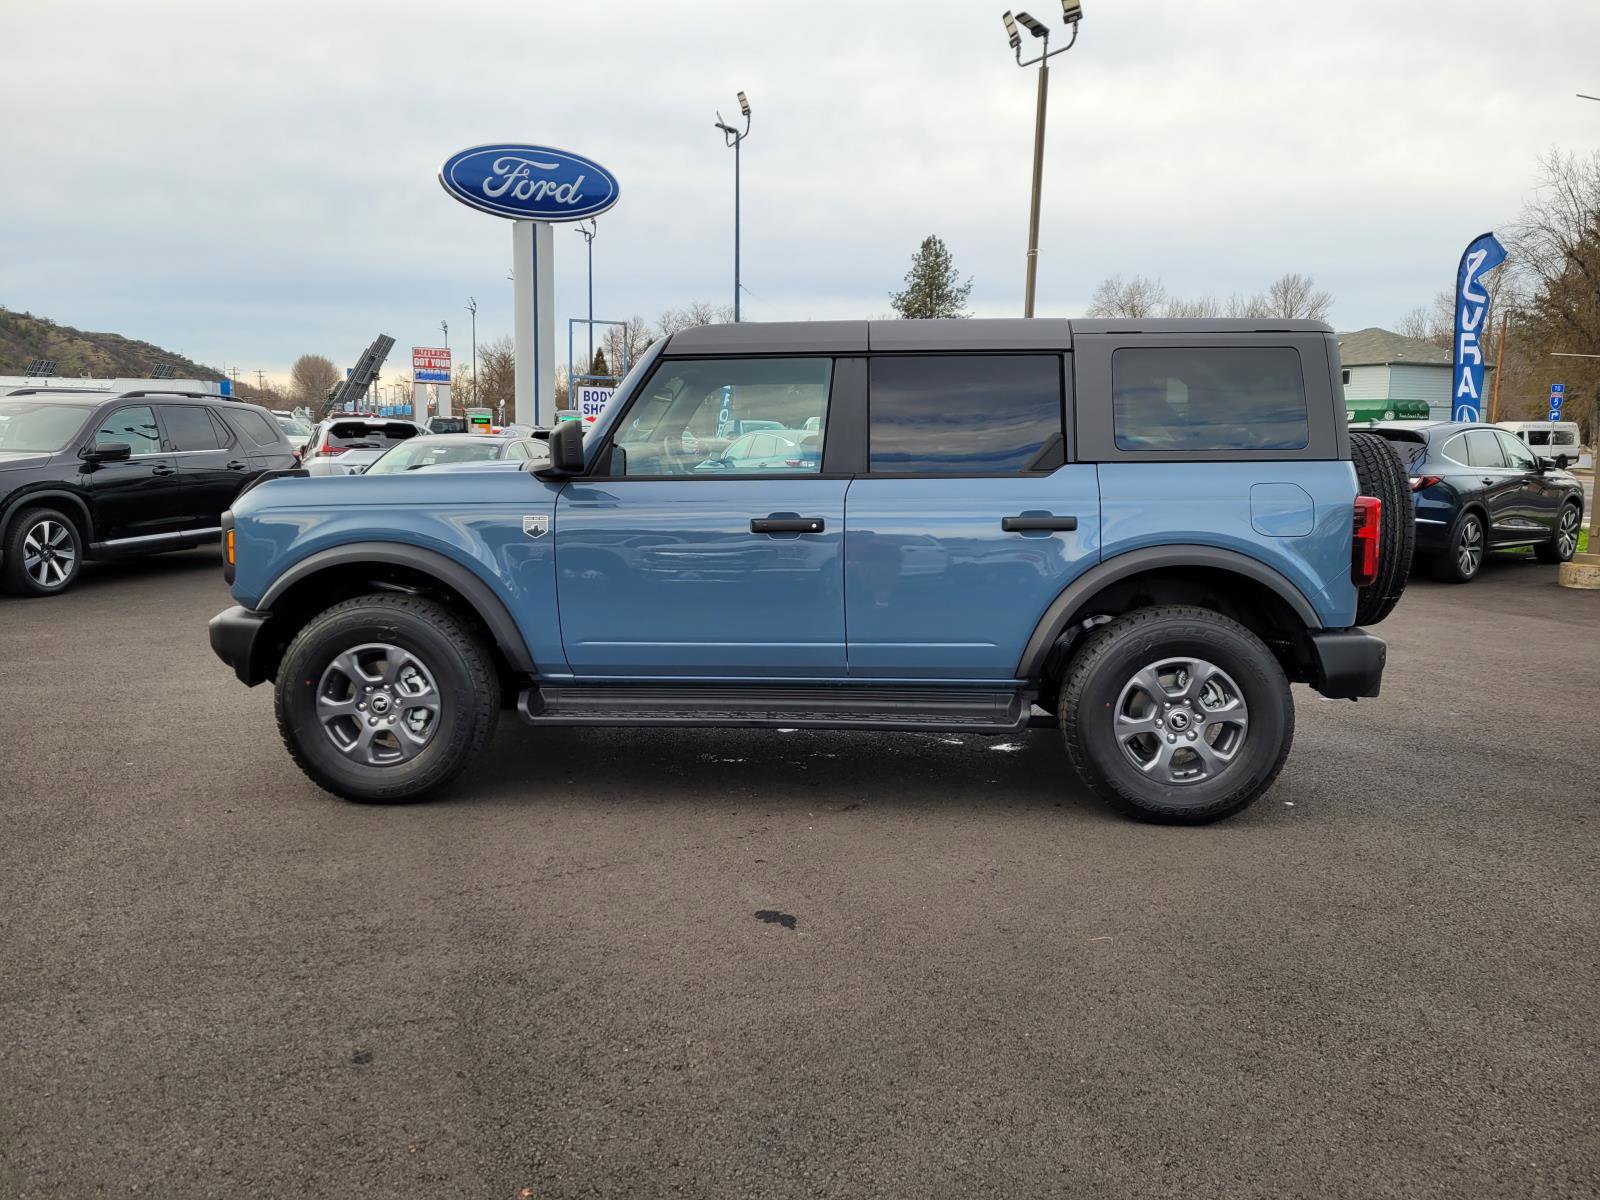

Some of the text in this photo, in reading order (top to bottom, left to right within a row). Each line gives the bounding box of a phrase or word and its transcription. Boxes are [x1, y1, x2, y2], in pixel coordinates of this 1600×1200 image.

[482, 156, 586, 205] Ford
[414, 358, 430, 367] GOT
[1553, 397, 1559, 406] 5
